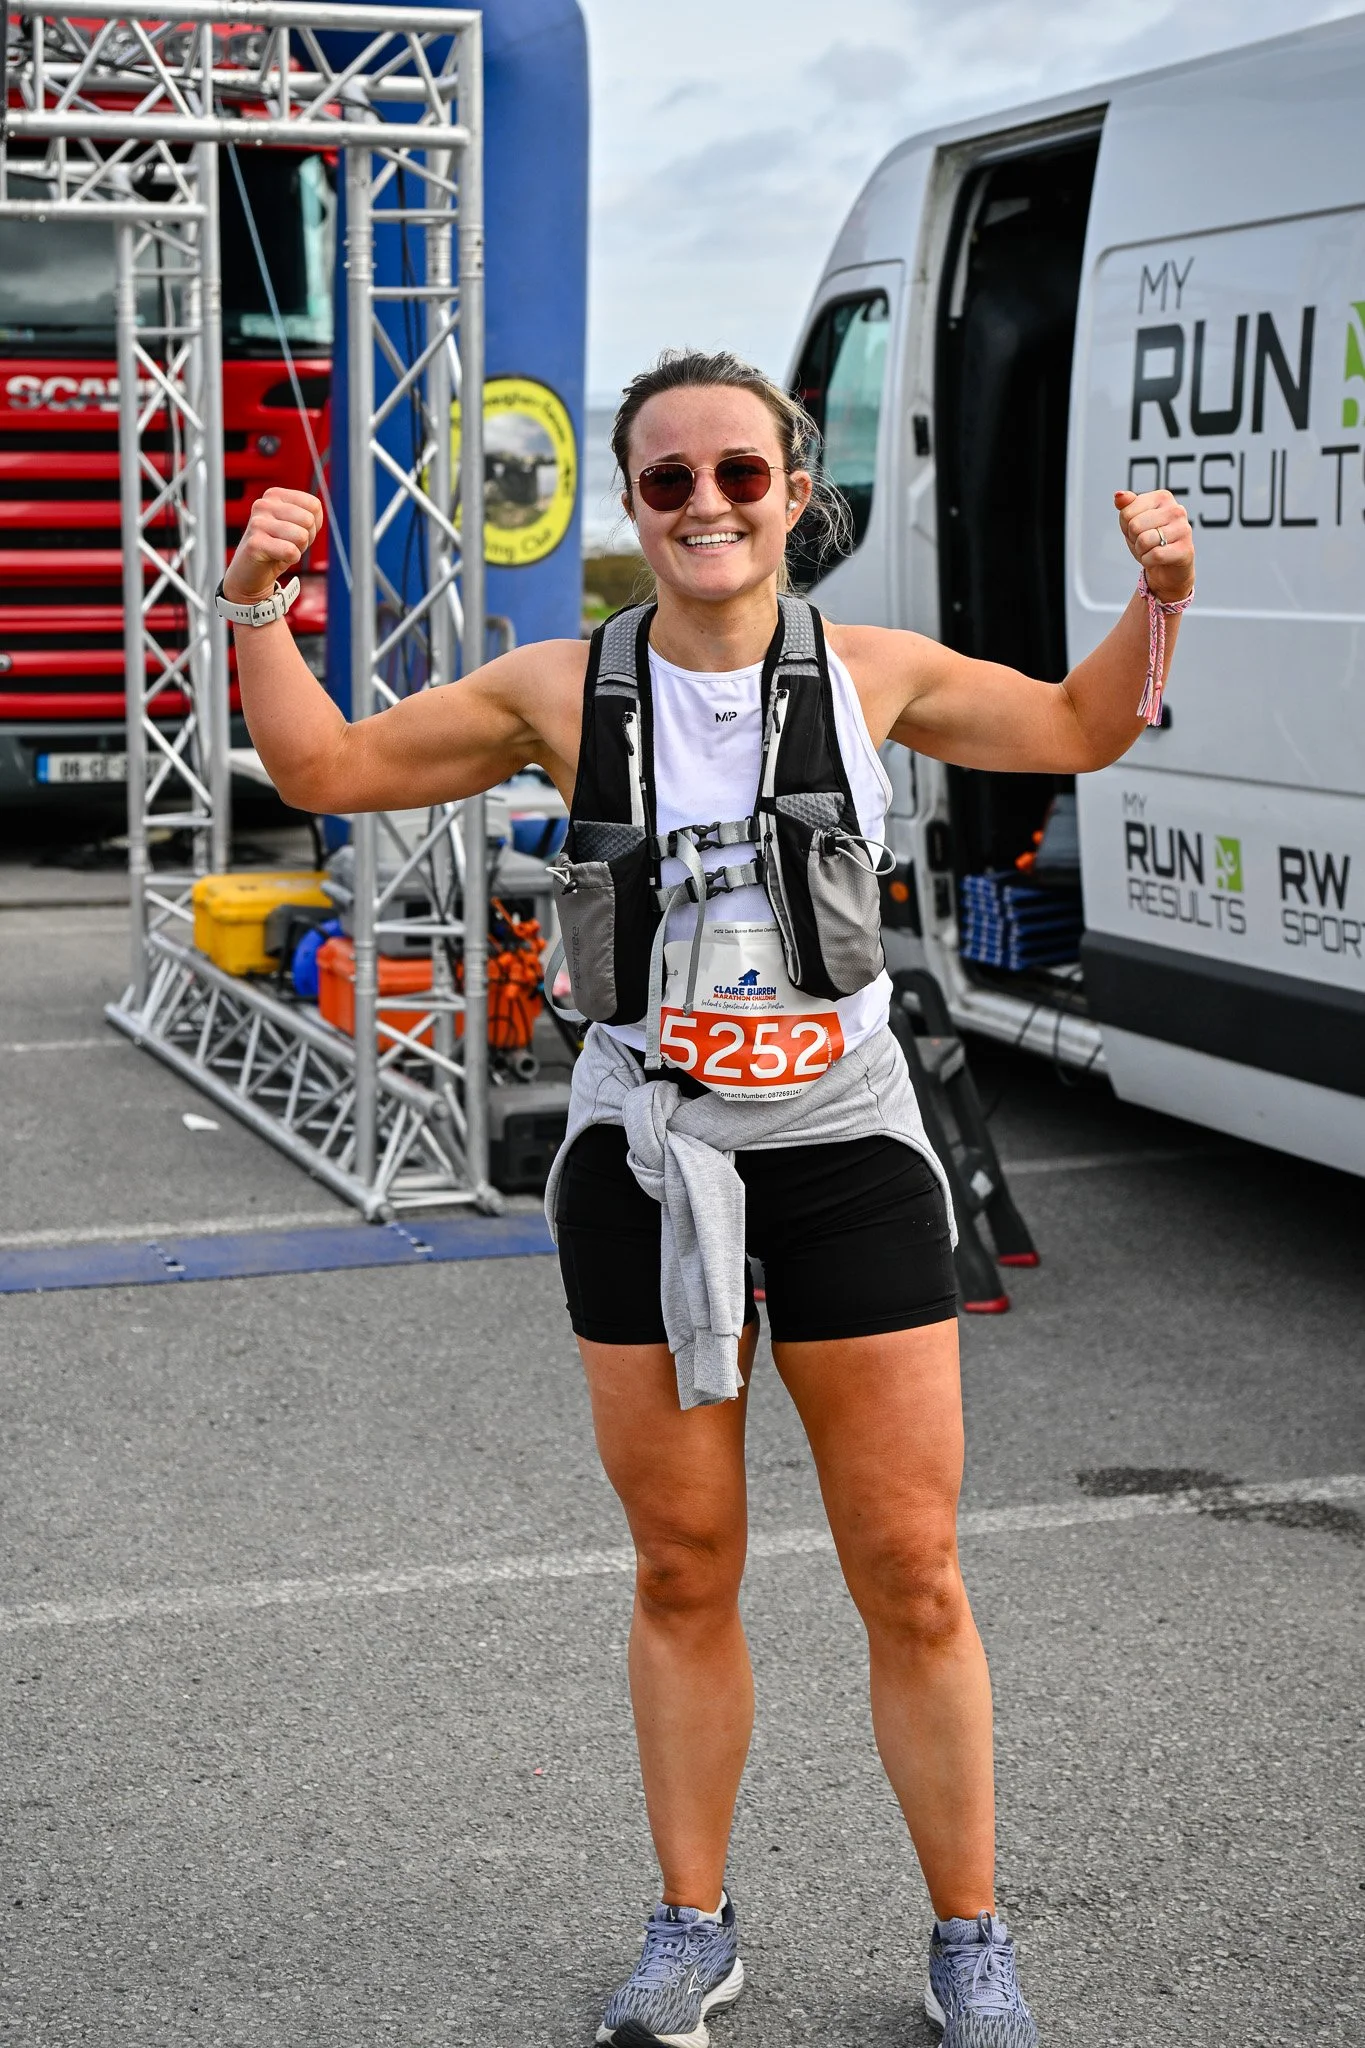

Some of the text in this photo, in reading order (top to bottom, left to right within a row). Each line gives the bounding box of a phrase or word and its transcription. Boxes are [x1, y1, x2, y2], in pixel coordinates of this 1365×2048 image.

[1138, 256, 1195, 315] MY
[6, 375, 187, 411] SCA
[1129, 305, 1317, 441] RUN
[1127, 444, 1365, 529] RESULT
[715, 711, 738, 723] MP
[1122, 790, 1148, 816] MY
[1124, 819, 1205, 886] RUN
[1277, 845, 1351, 911] RW
[1127, 877, 1247, 935] RESULTS
[1281, 908, 1365, 960] SPOR
[713, 985, 777, 996] CLARE BURREN
[713, 993, 751, 1001] MARATHON
[661, 1014, 829, 1079] 5252
